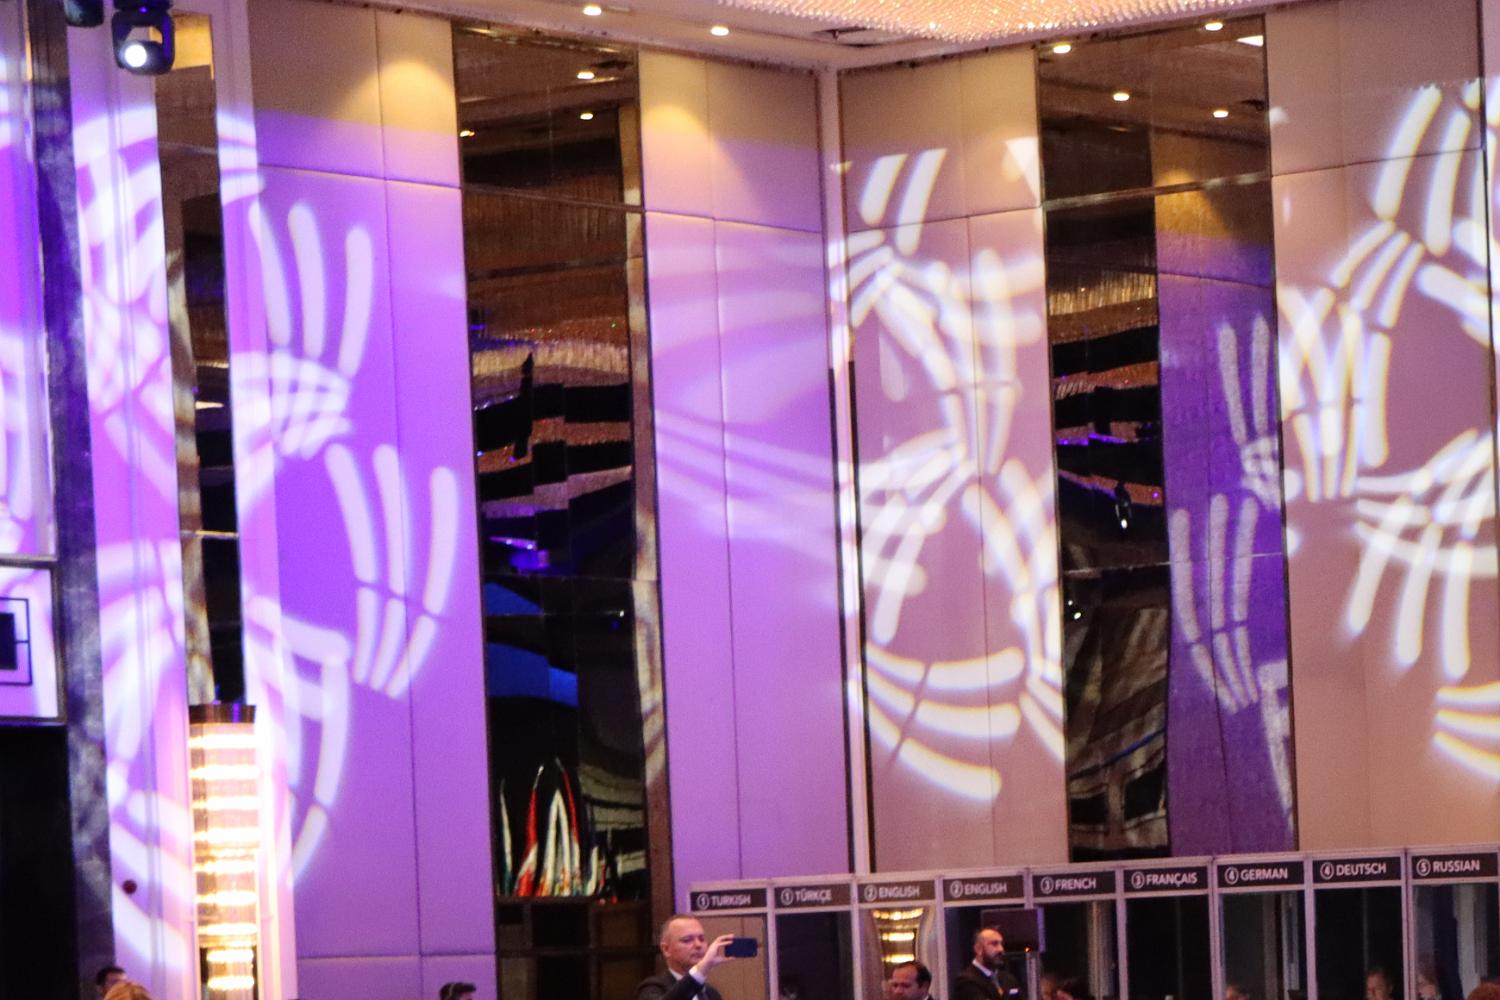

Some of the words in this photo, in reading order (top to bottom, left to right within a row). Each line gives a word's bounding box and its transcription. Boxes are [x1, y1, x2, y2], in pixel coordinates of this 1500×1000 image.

[1336, 862, 1387, 876] DEUTSCH
[1432, 859, 1480, 873] RUSSIAN
[1146, 872, 1198, 887] FRANÇAIS
[1240, 868, 1288, 881] GERMAN
[964, 883, 1008, 895] ENGLISH
[1055, 877, 1096, 891] FRENCH
[795, 887, 832, 902] TÜRKÇE
[878, 886, 921, 899] ENGLISH
[711, 894, 752, 907] TURKISH
